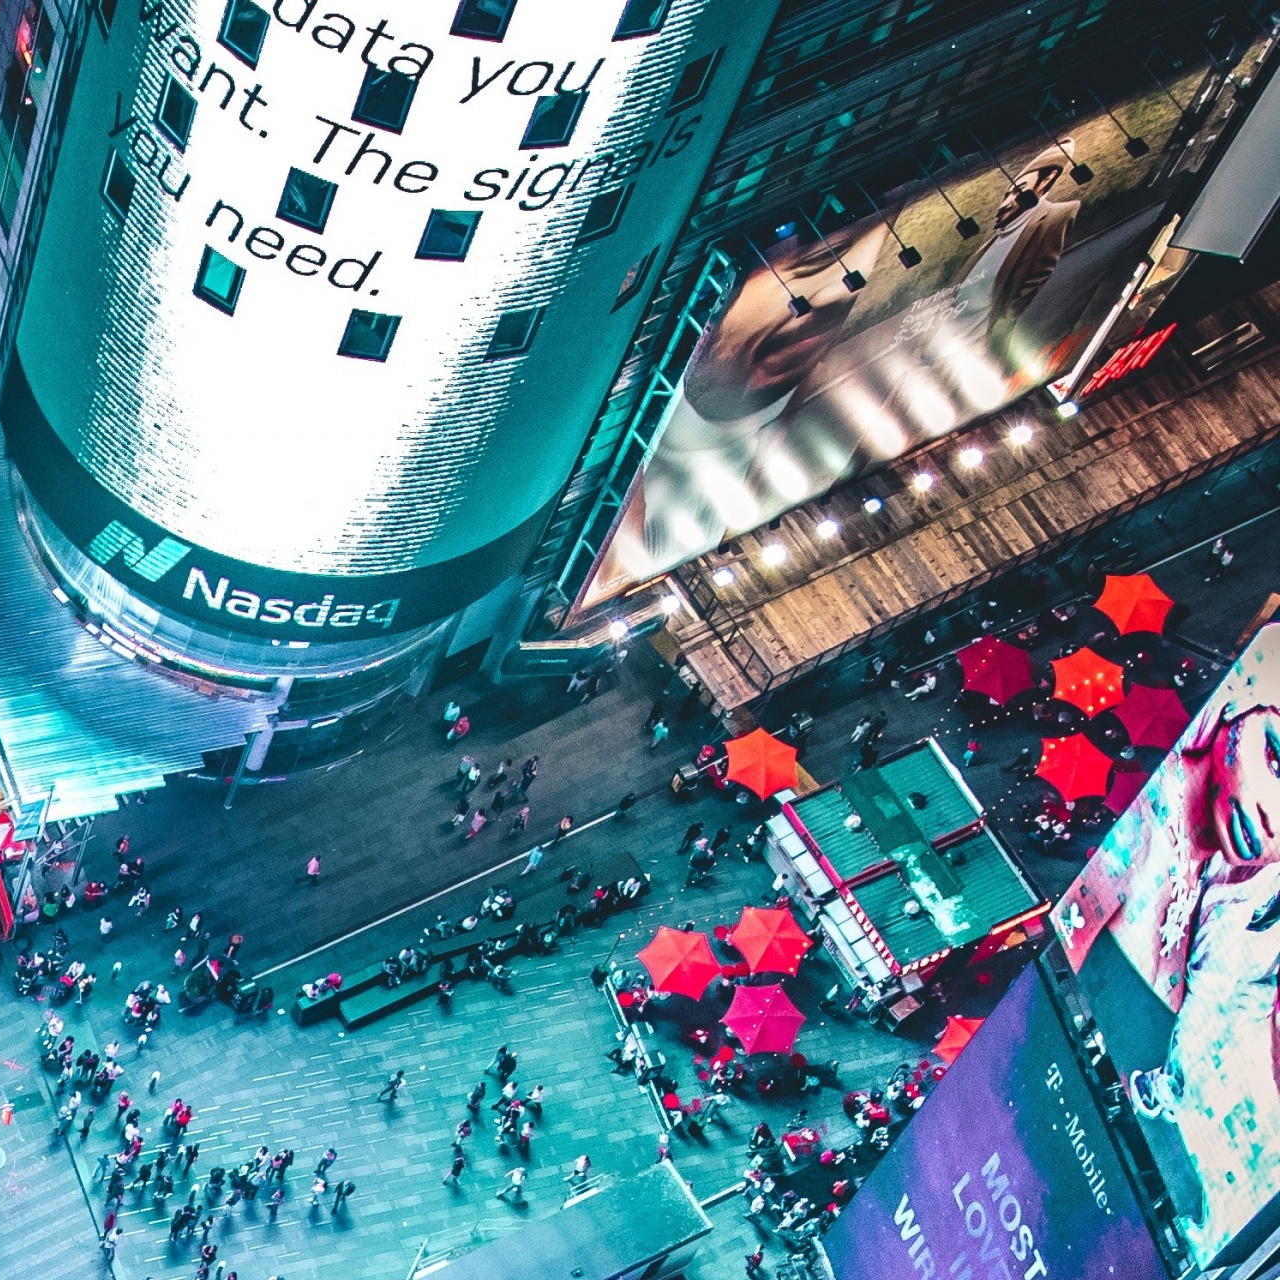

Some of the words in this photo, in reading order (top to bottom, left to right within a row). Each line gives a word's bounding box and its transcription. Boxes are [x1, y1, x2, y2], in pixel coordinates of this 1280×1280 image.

[459, 56, 606, 103] you
[312, 115, 439, 196] The
[464, 114, 703, 212] signals
[204, 198, 381, 297] need.
[182, 566, 400, 630] Nasdaq
